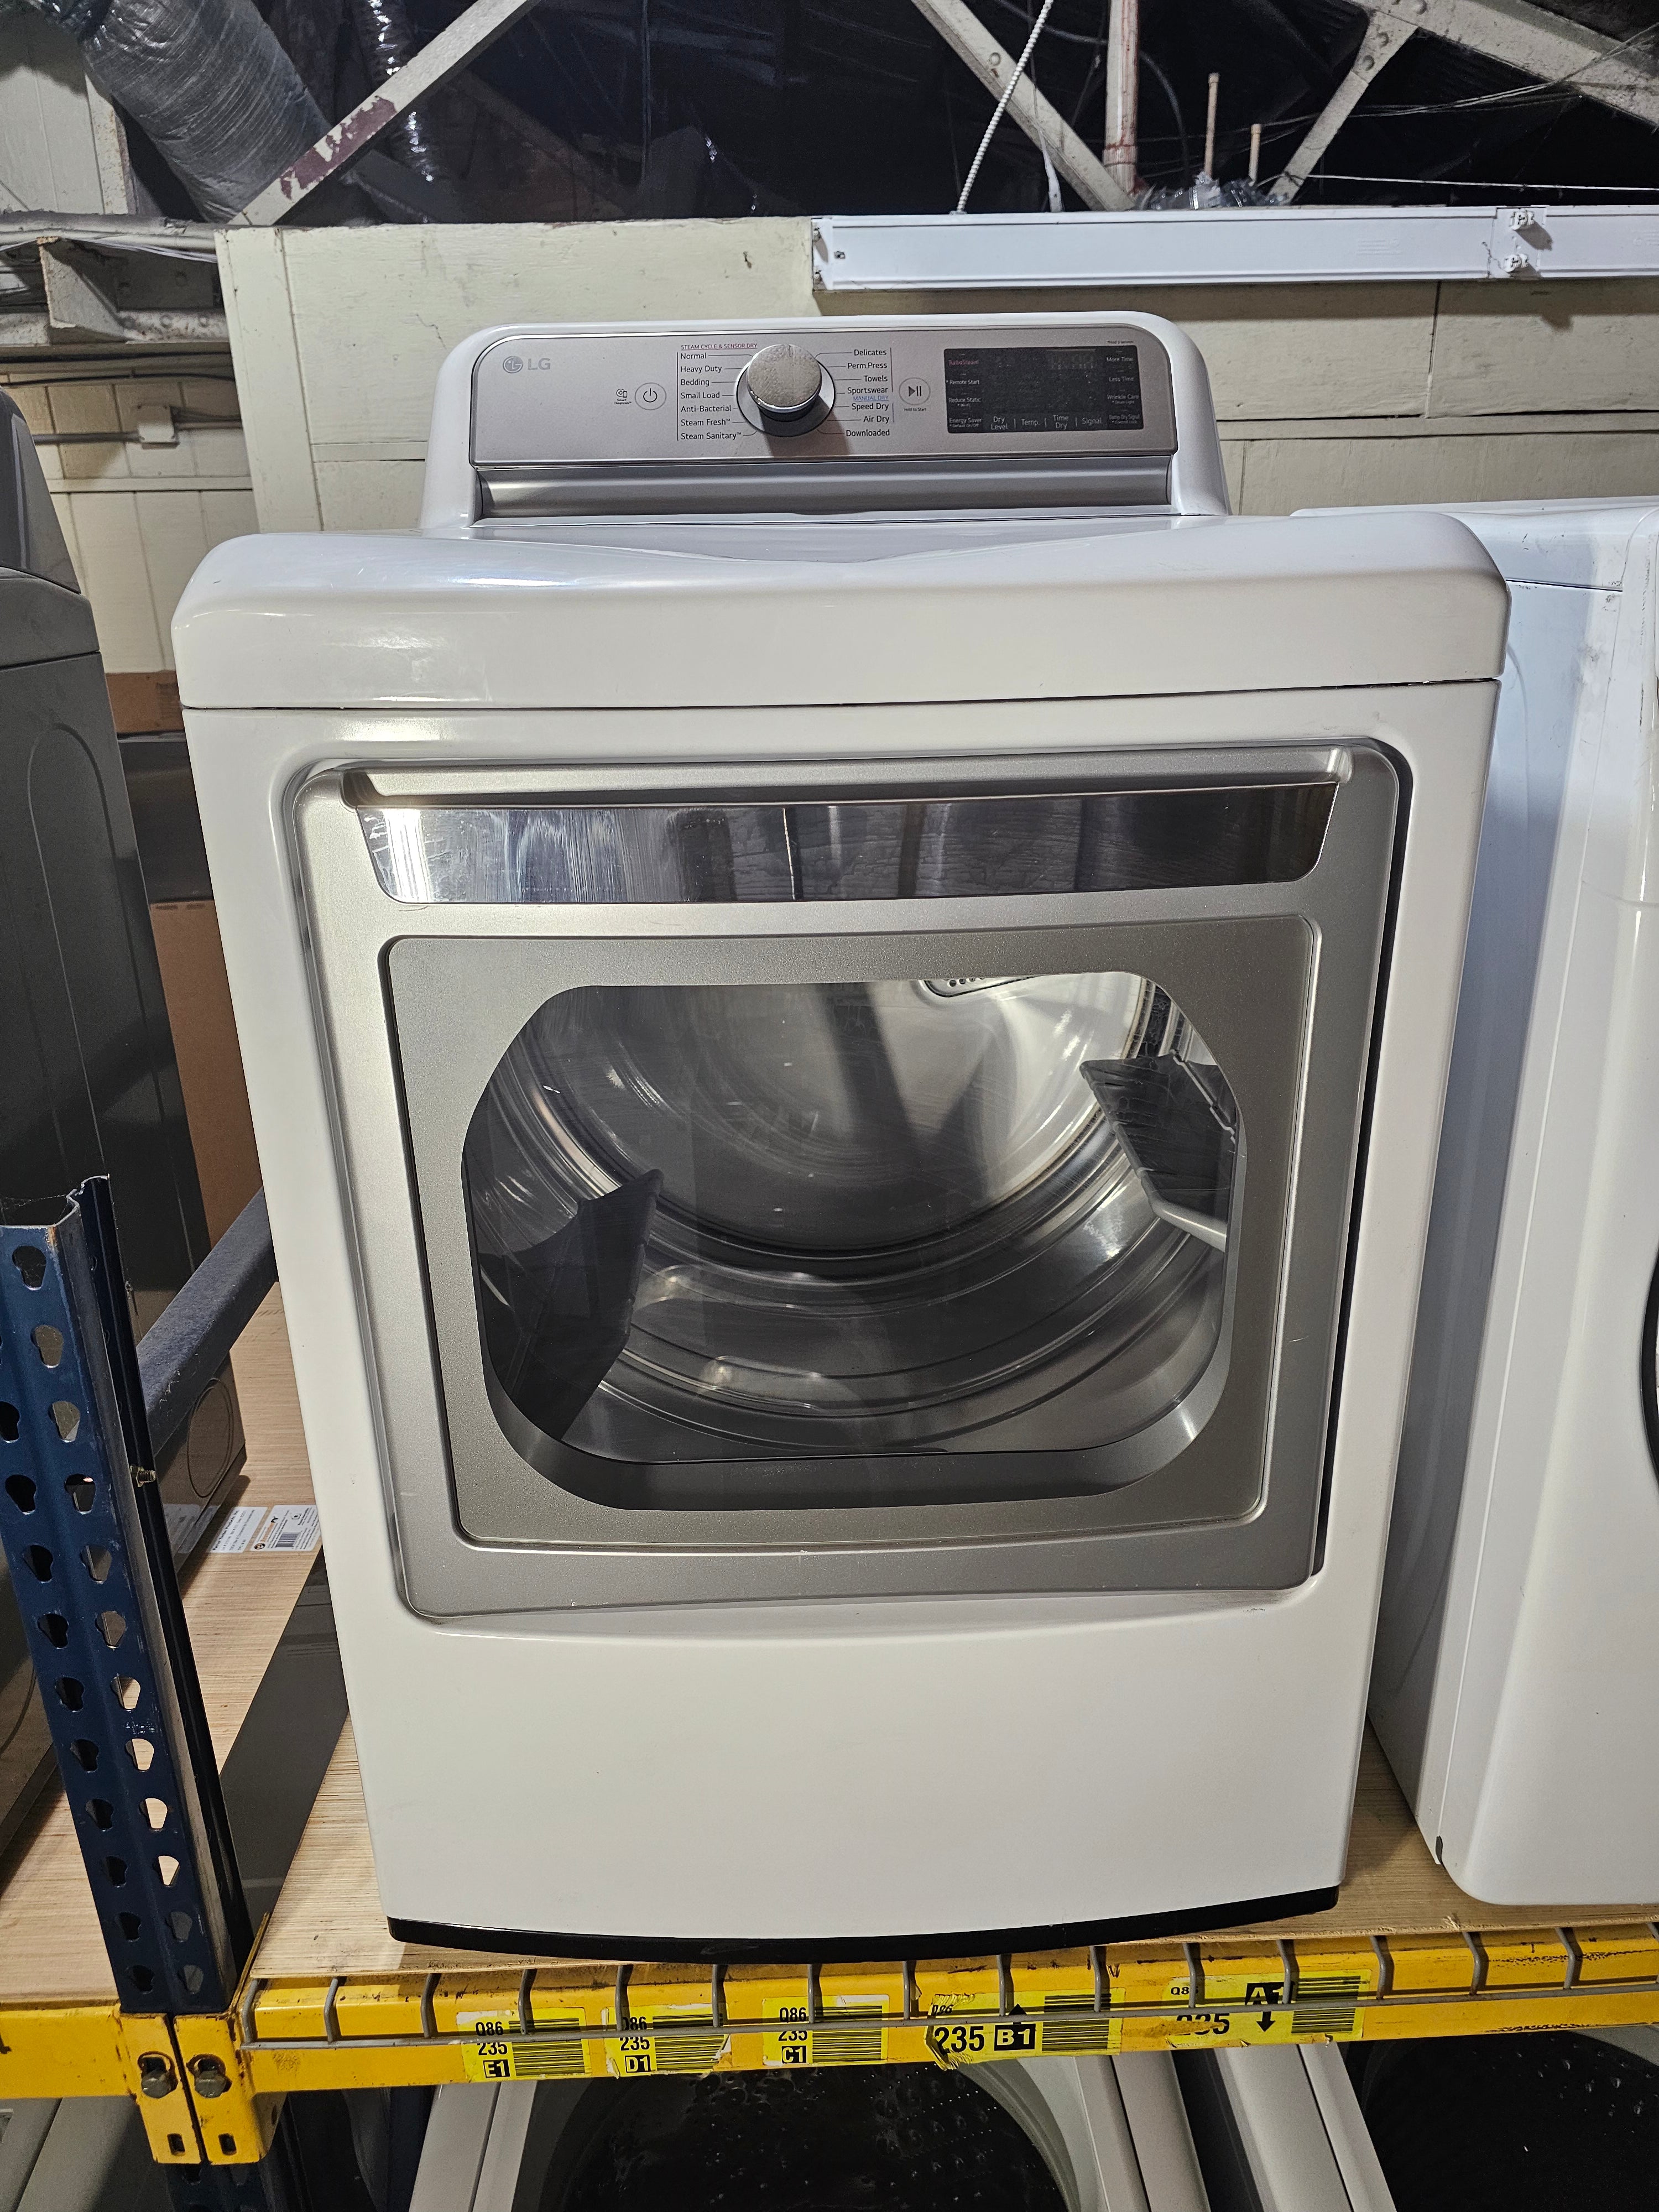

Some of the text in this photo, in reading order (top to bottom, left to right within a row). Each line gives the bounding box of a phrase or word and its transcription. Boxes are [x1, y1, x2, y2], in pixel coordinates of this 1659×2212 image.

[528, 358, 551, 371] LG
[847, 387, 888, 395] Sportswear
[852, 403, 889, 411] Speed Dry
[877, 415, 890, 424] Dry
[993, 416, 1005, 424] Dry
[1082, 418, 1102, 426] Signal
[1055, 422, 1068, 430] Dry
[778, 2030, 808, 2042] 235
[934, 2026, 1031, 2054] 235 B1
[477, 2042, 508, 2056] 235
[619, 2037, 650, 2051] 235
[782, 2047, 804, 2063] C1
[484, 2060, 506, 2077] E1
[625, 2056, 649, 2072] D1
